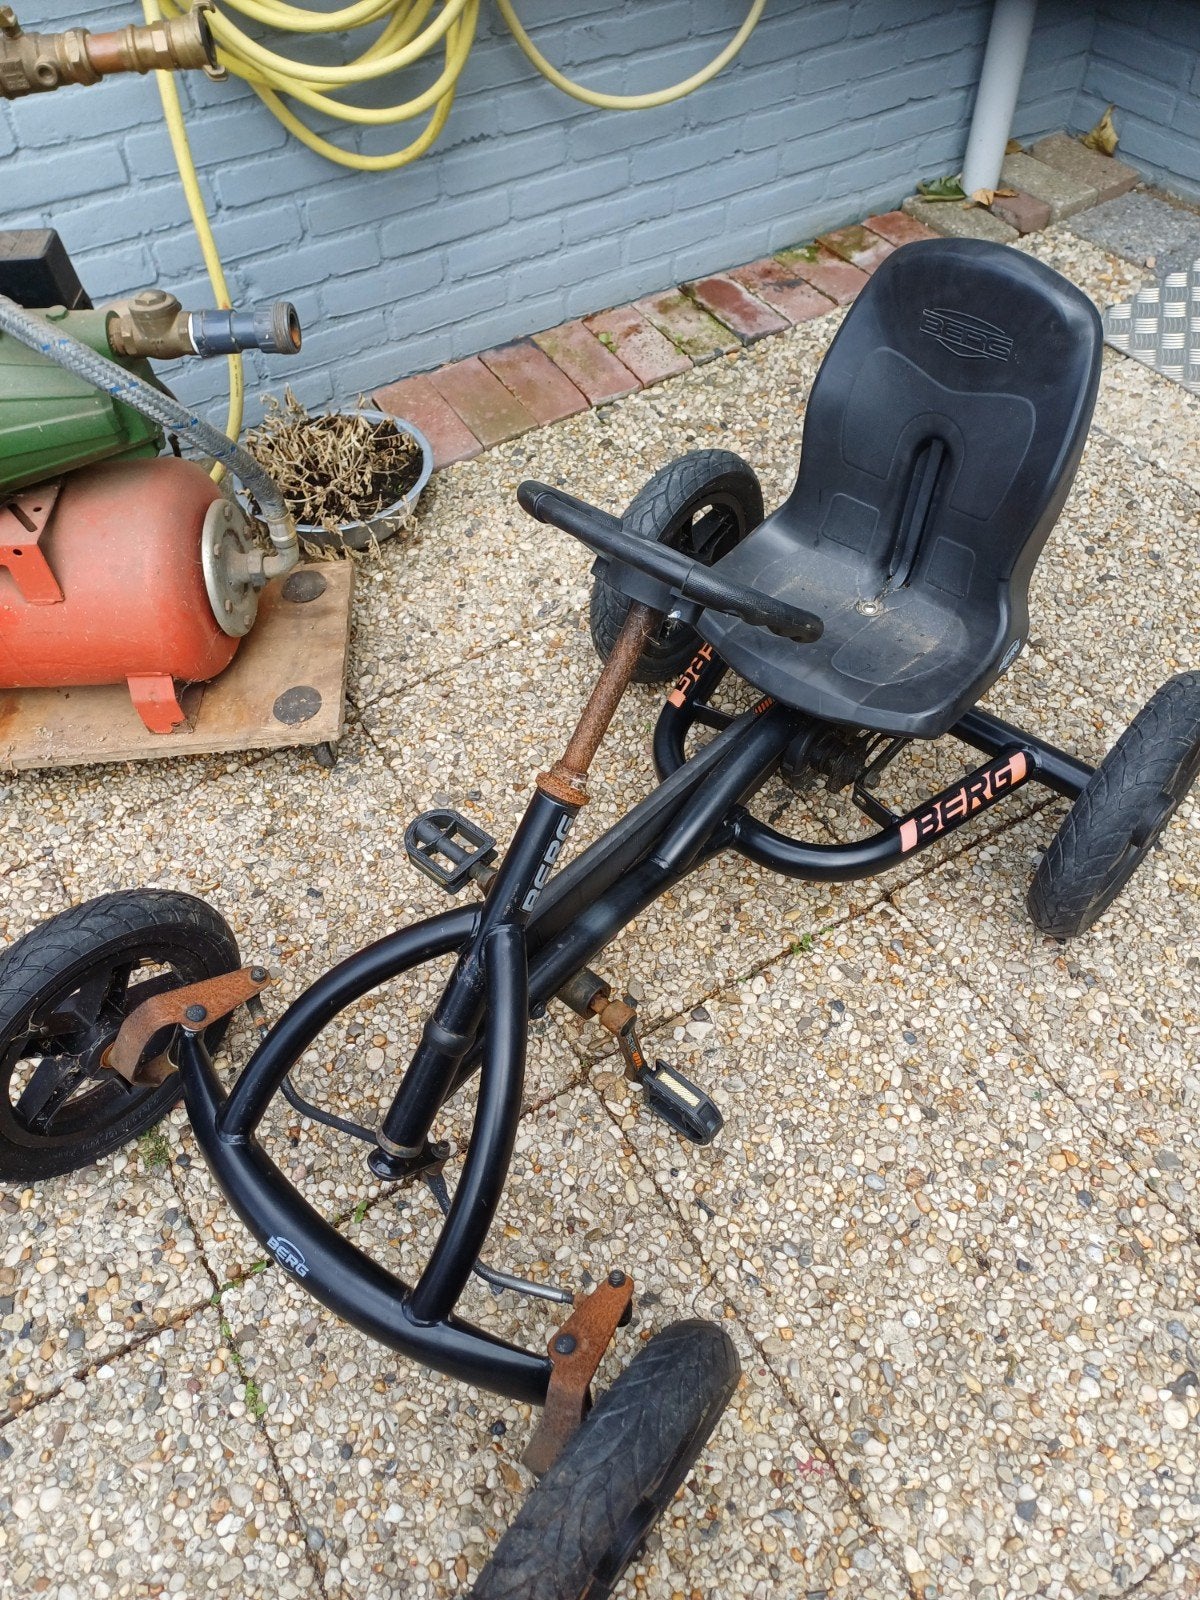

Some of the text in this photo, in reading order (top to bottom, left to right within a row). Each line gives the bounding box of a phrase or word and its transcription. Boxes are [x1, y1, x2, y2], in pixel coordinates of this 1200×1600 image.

[672, 641, 714, 694] ERG
[915, 756, 1013, 844] BERG
[521, 813, 575, 913] BERG
[266, 1235, 310, 1278] BERG
